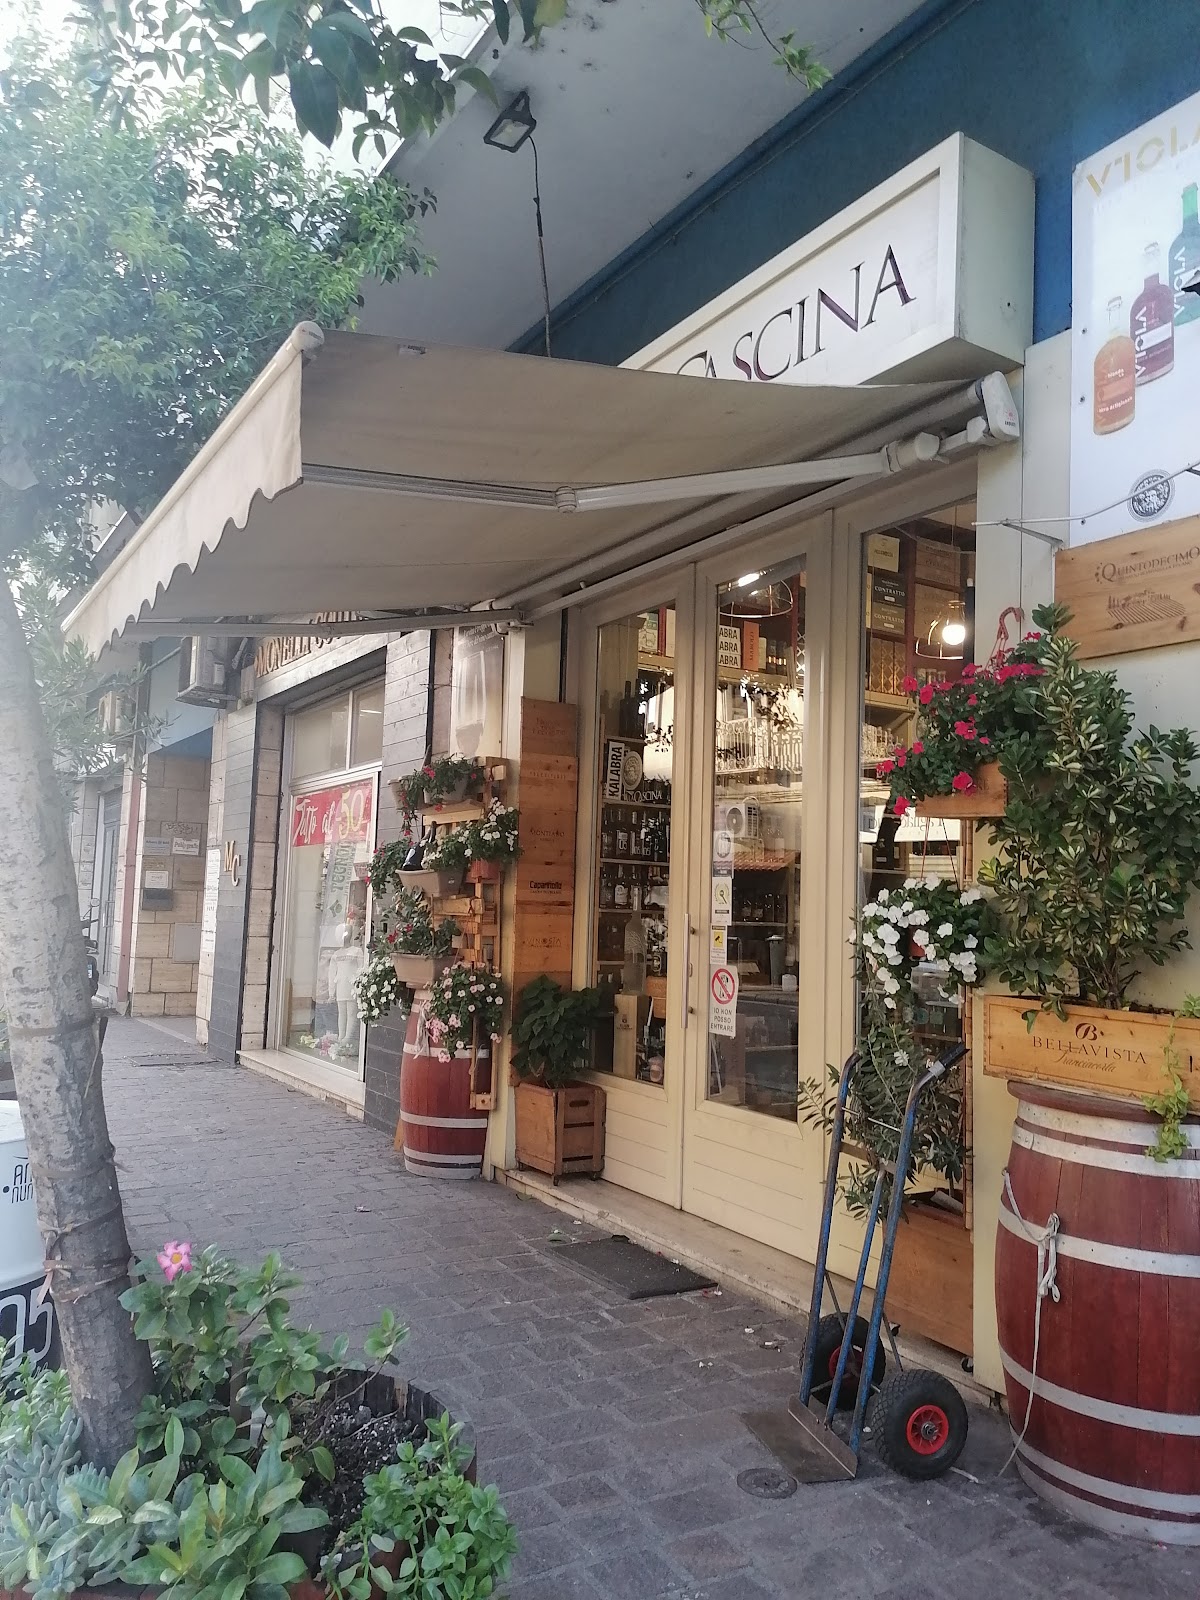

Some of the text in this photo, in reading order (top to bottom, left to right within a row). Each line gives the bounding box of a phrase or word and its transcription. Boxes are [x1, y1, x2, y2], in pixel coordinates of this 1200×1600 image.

[1135, 306, 1147, 378] VIOLA
[1101, 546, 1200, 582] QUINTODECIMO
[874, 586, 906, 598] CONTRATTO
[873, 613, 905, 625] CONTRATTO
[608, 746, 623, 798] KALABRA
[710, 1023, 734, 1033] ENTRARE
[713, 1016, 732, 1024] POSSO
[1032, 1035, 1147, 1065] BELLAVISTA
[1054, 1050, 1117, 1073] Franciacorta
